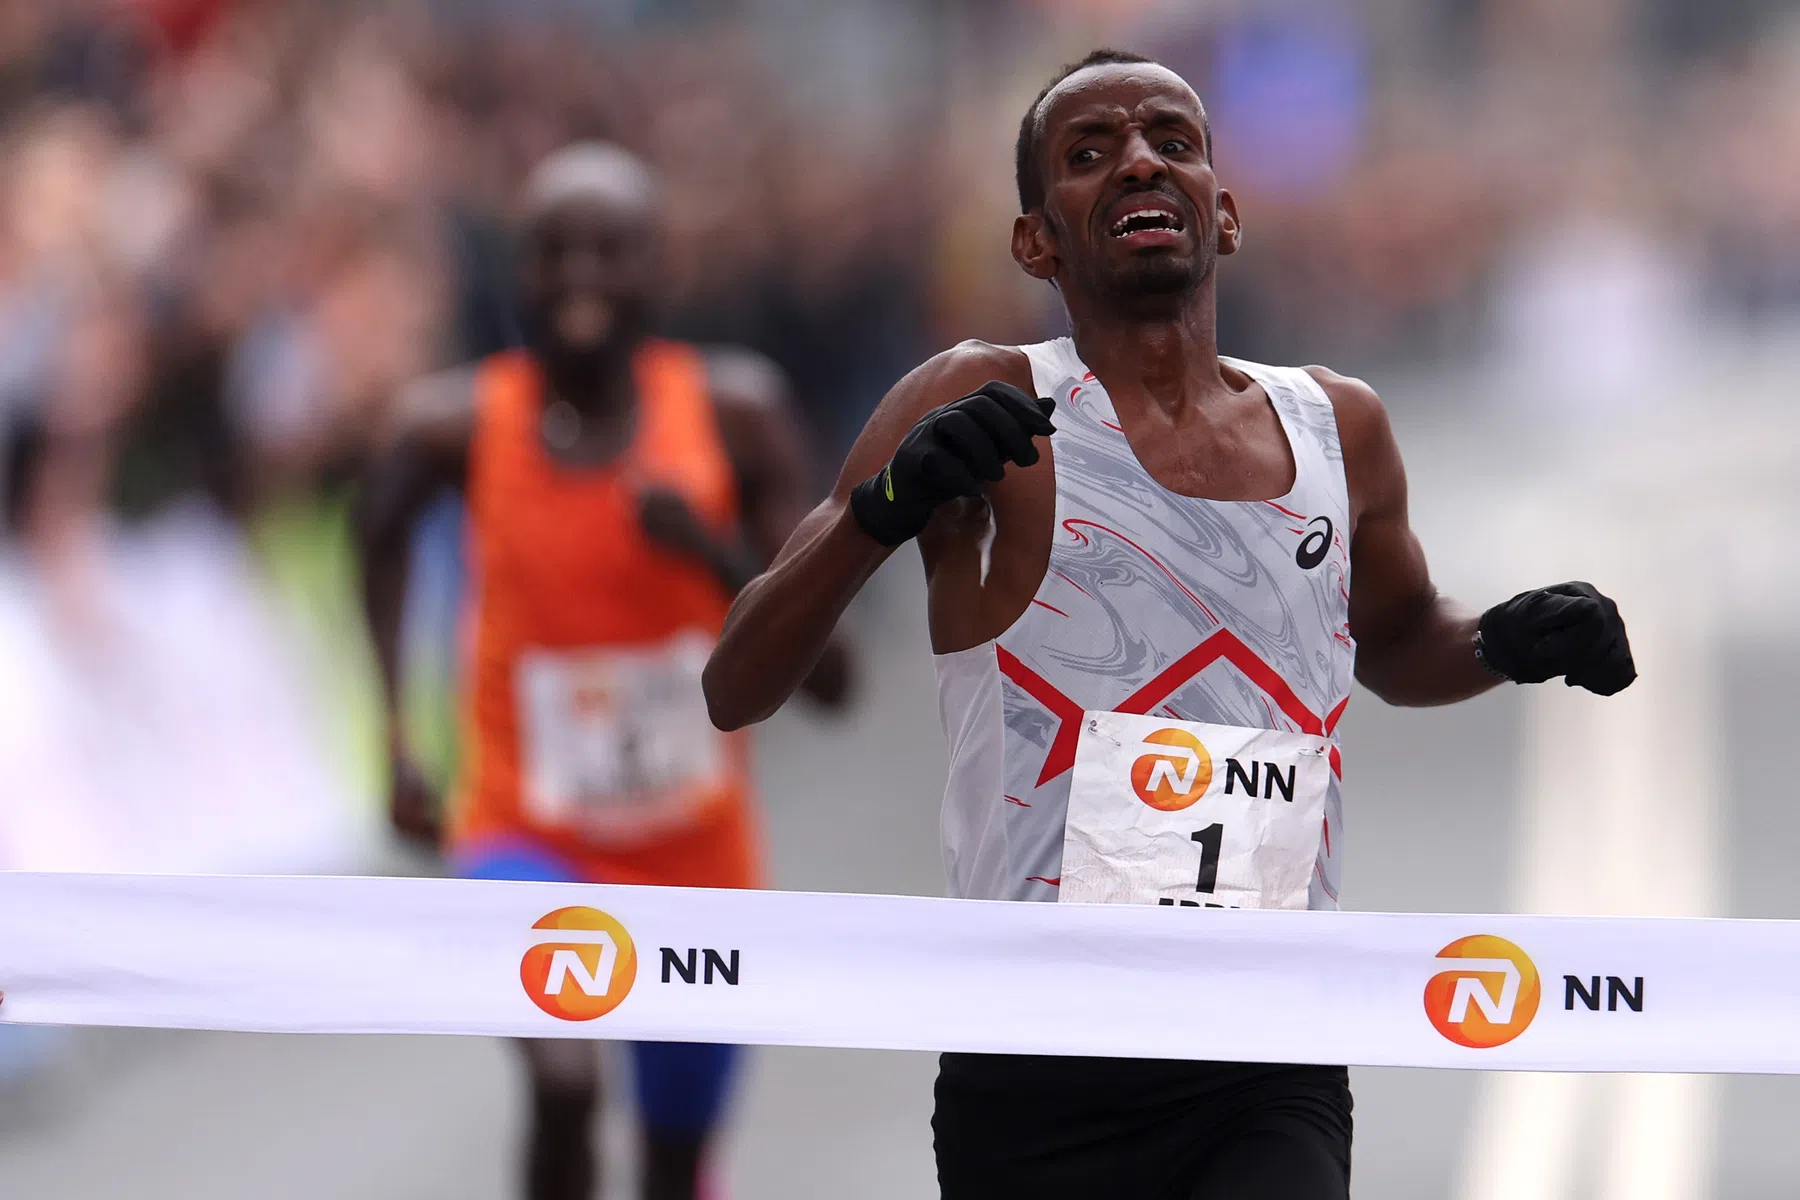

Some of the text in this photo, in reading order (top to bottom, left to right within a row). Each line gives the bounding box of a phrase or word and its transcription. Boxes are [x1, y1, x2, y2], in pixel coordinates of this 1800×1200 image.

[1225, 757, 1297, 803] NN
[1190, 822, 1224, 894] 1
[659, 947, 740, 986] NN
[1562, 974, 1644, 1012] NN
